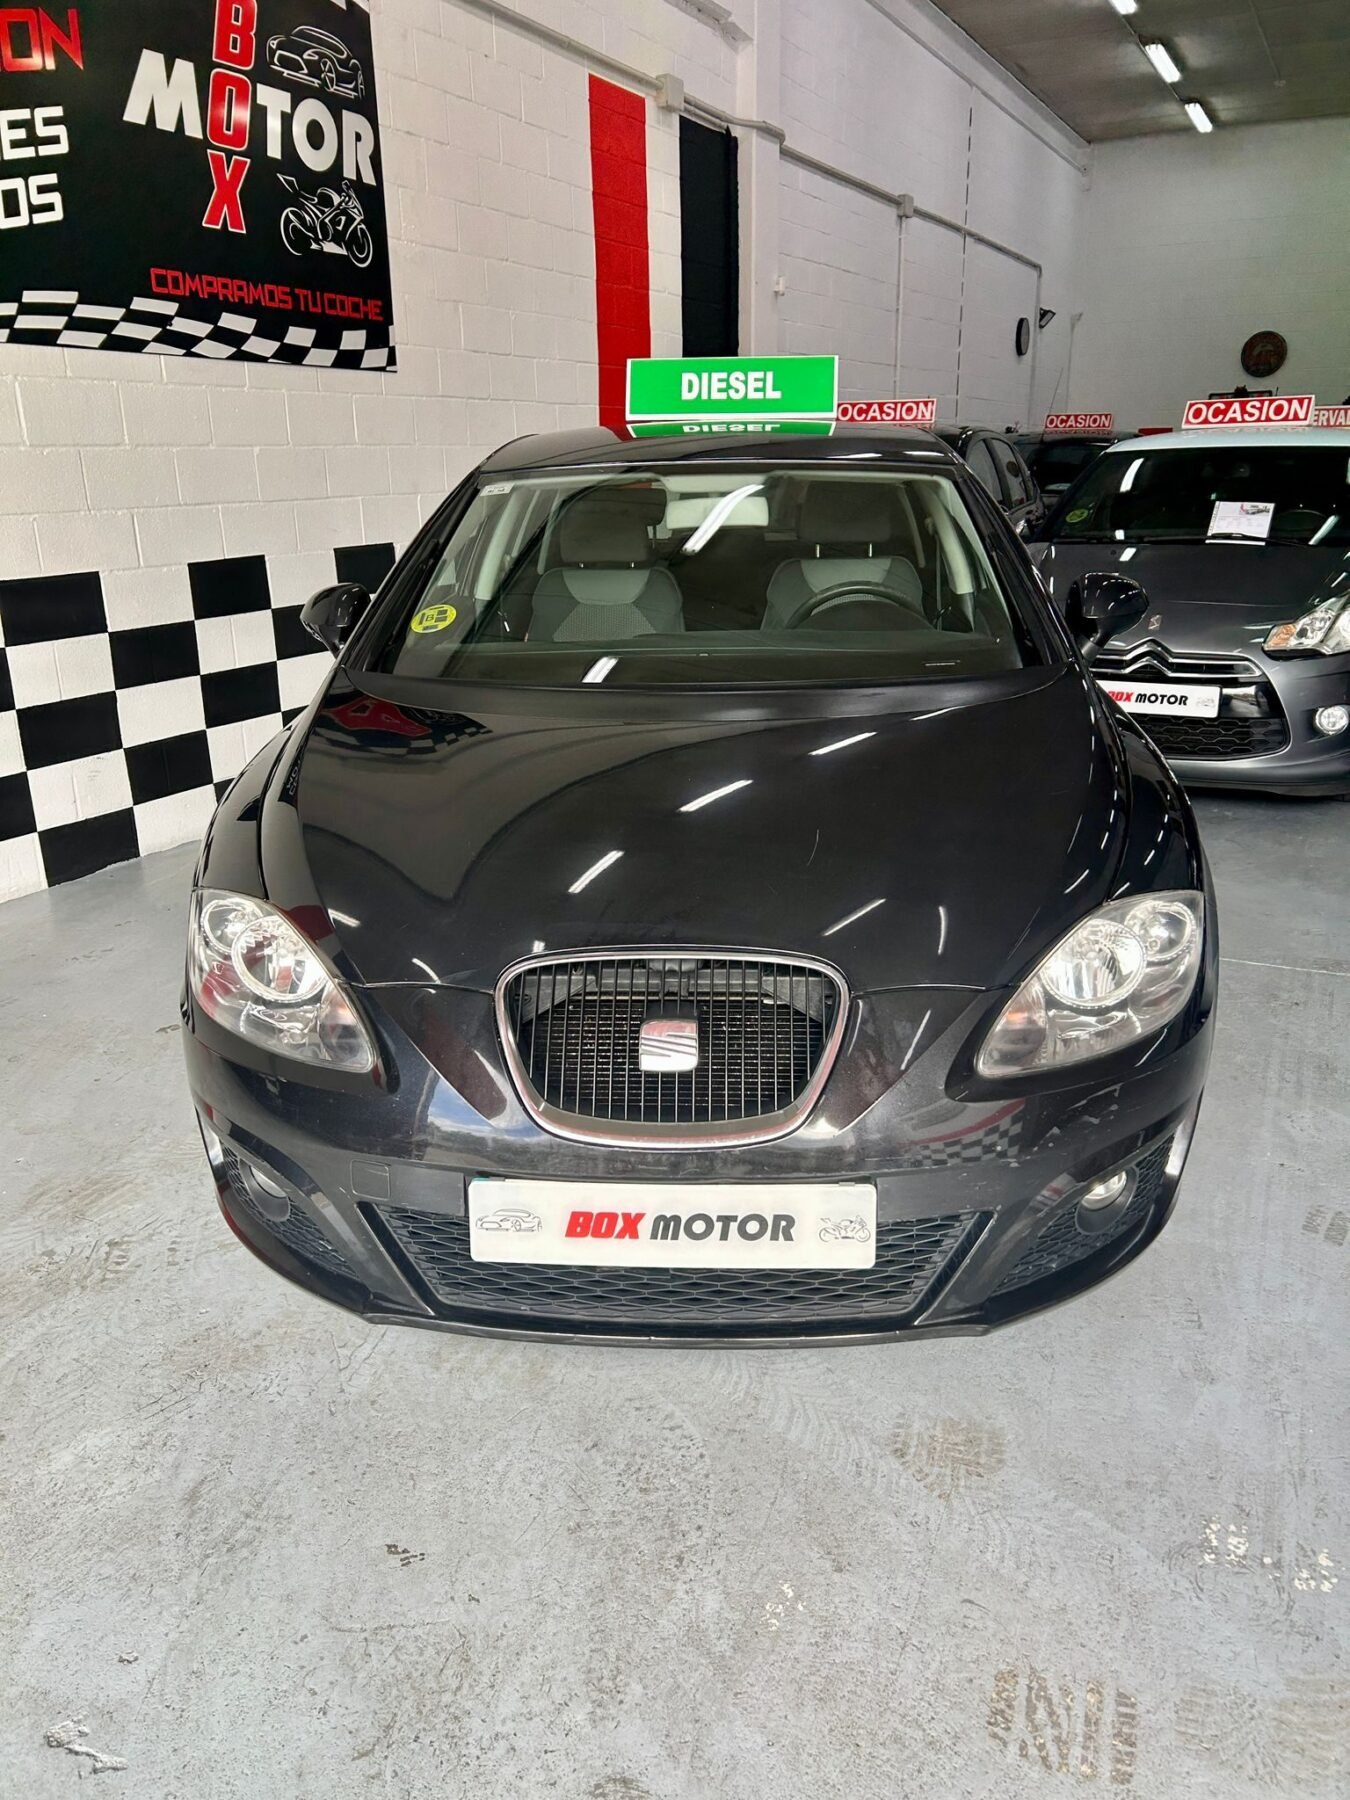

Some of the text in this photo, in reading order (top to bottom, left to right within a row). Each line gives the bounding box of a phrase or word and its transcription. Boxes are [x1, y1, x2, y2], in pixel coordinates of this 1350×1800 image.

[122, 48, 377, 187] MOTOR
[202, 0, 257, 234] BOX
[0, 106, 69, 160] ES
[150, 267, 384, 321] COMPRAMOS TU COCHE
[681, 371, 782, 400] DIESEL
[838, 402, 932, 421] OCASION
[1046, 414, 1112, 428] OCASION
[1187, 399, 1310, 424] OCASION
[1135, 693, 1189, 706] MOTOR
[564, 1210, 796, 1242] BOX MOTOR
